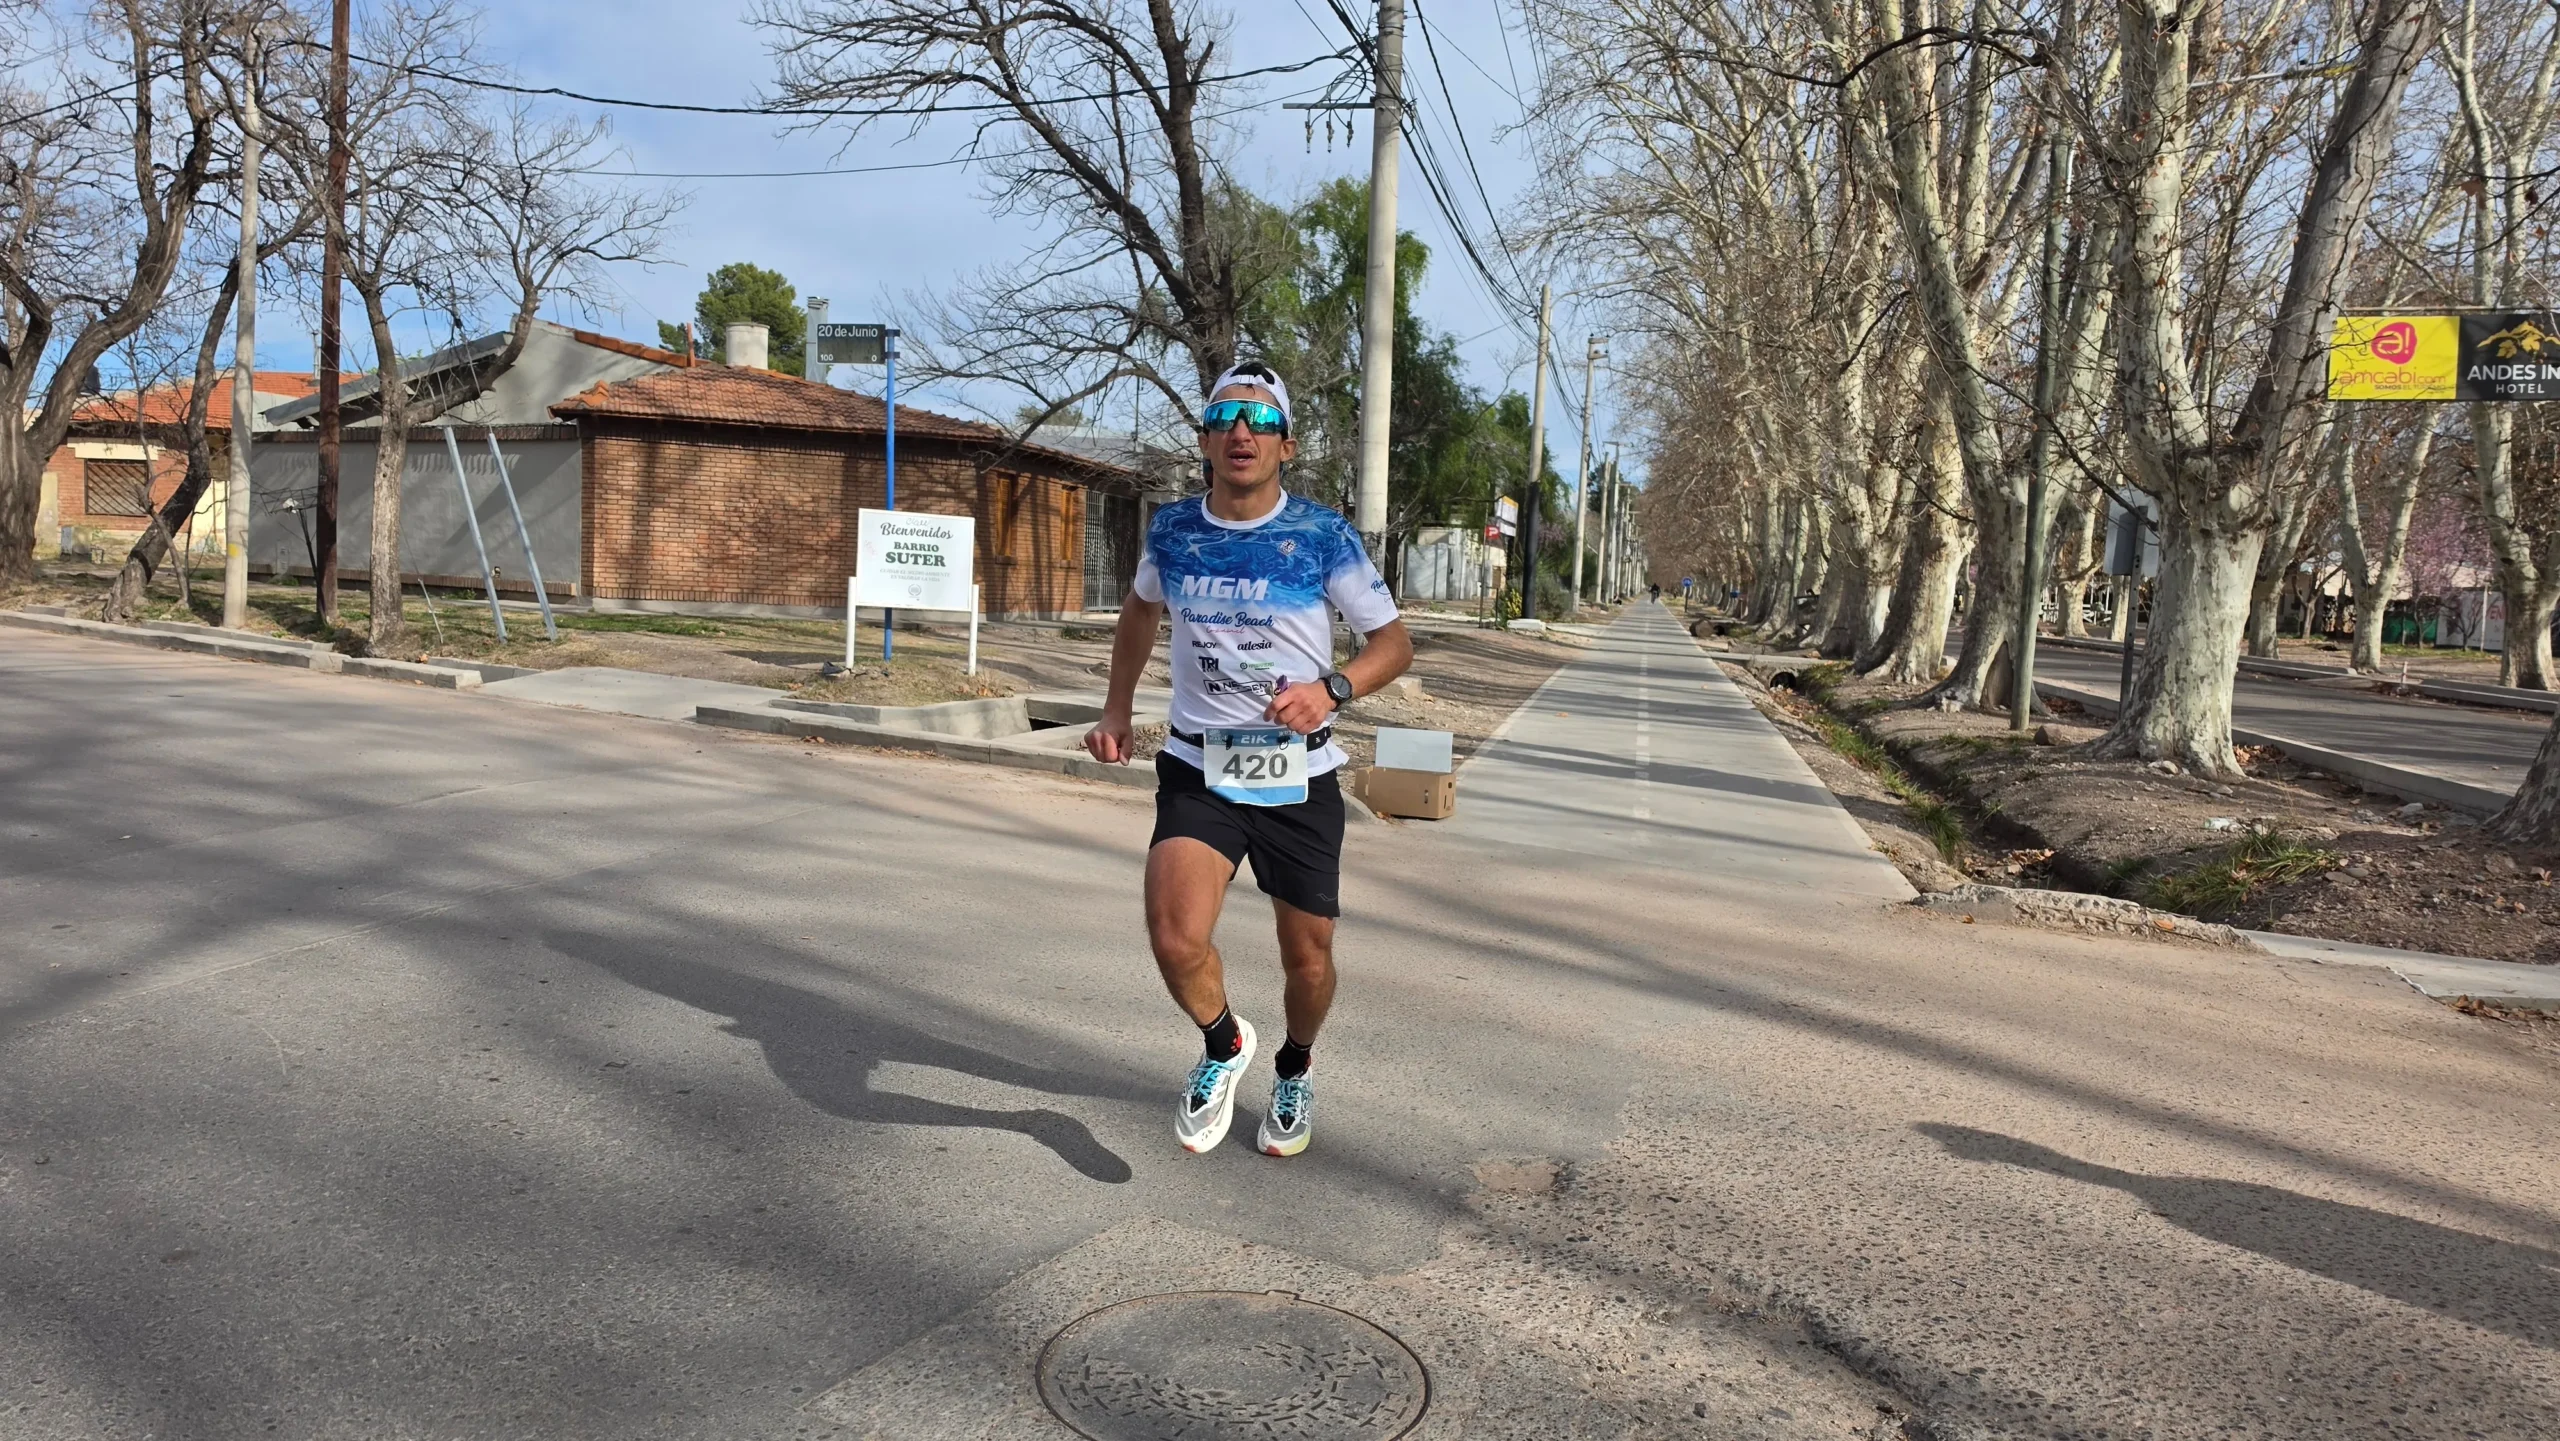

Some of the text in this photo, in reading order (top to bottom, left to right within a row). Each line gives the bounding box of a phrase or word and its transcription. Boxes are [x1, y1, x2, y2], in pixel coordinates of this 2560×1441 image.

[818, 325, 878, 337] 20 de Junio
[871, 354, 877, 362] 0
[2467, 364, 2537, 381] ANDES
[2495, 383, 2545, 394] HOTEL
[880, 522, 954, 540] Bienvenidos
[894, 541, 940, 552] BARRIO
[885, 552, 947, 567] SUTER
[1180, 575, 1269, 601] MGM
[1180, 607, 1275, 628] Paradise Beach
[1237, 640, 1272, 651] atlesia
[1198, 656, 1220, 670] TRI
[1240, 734, 1268, 744] 21K
[1222, 753, 1288, 780] 420
